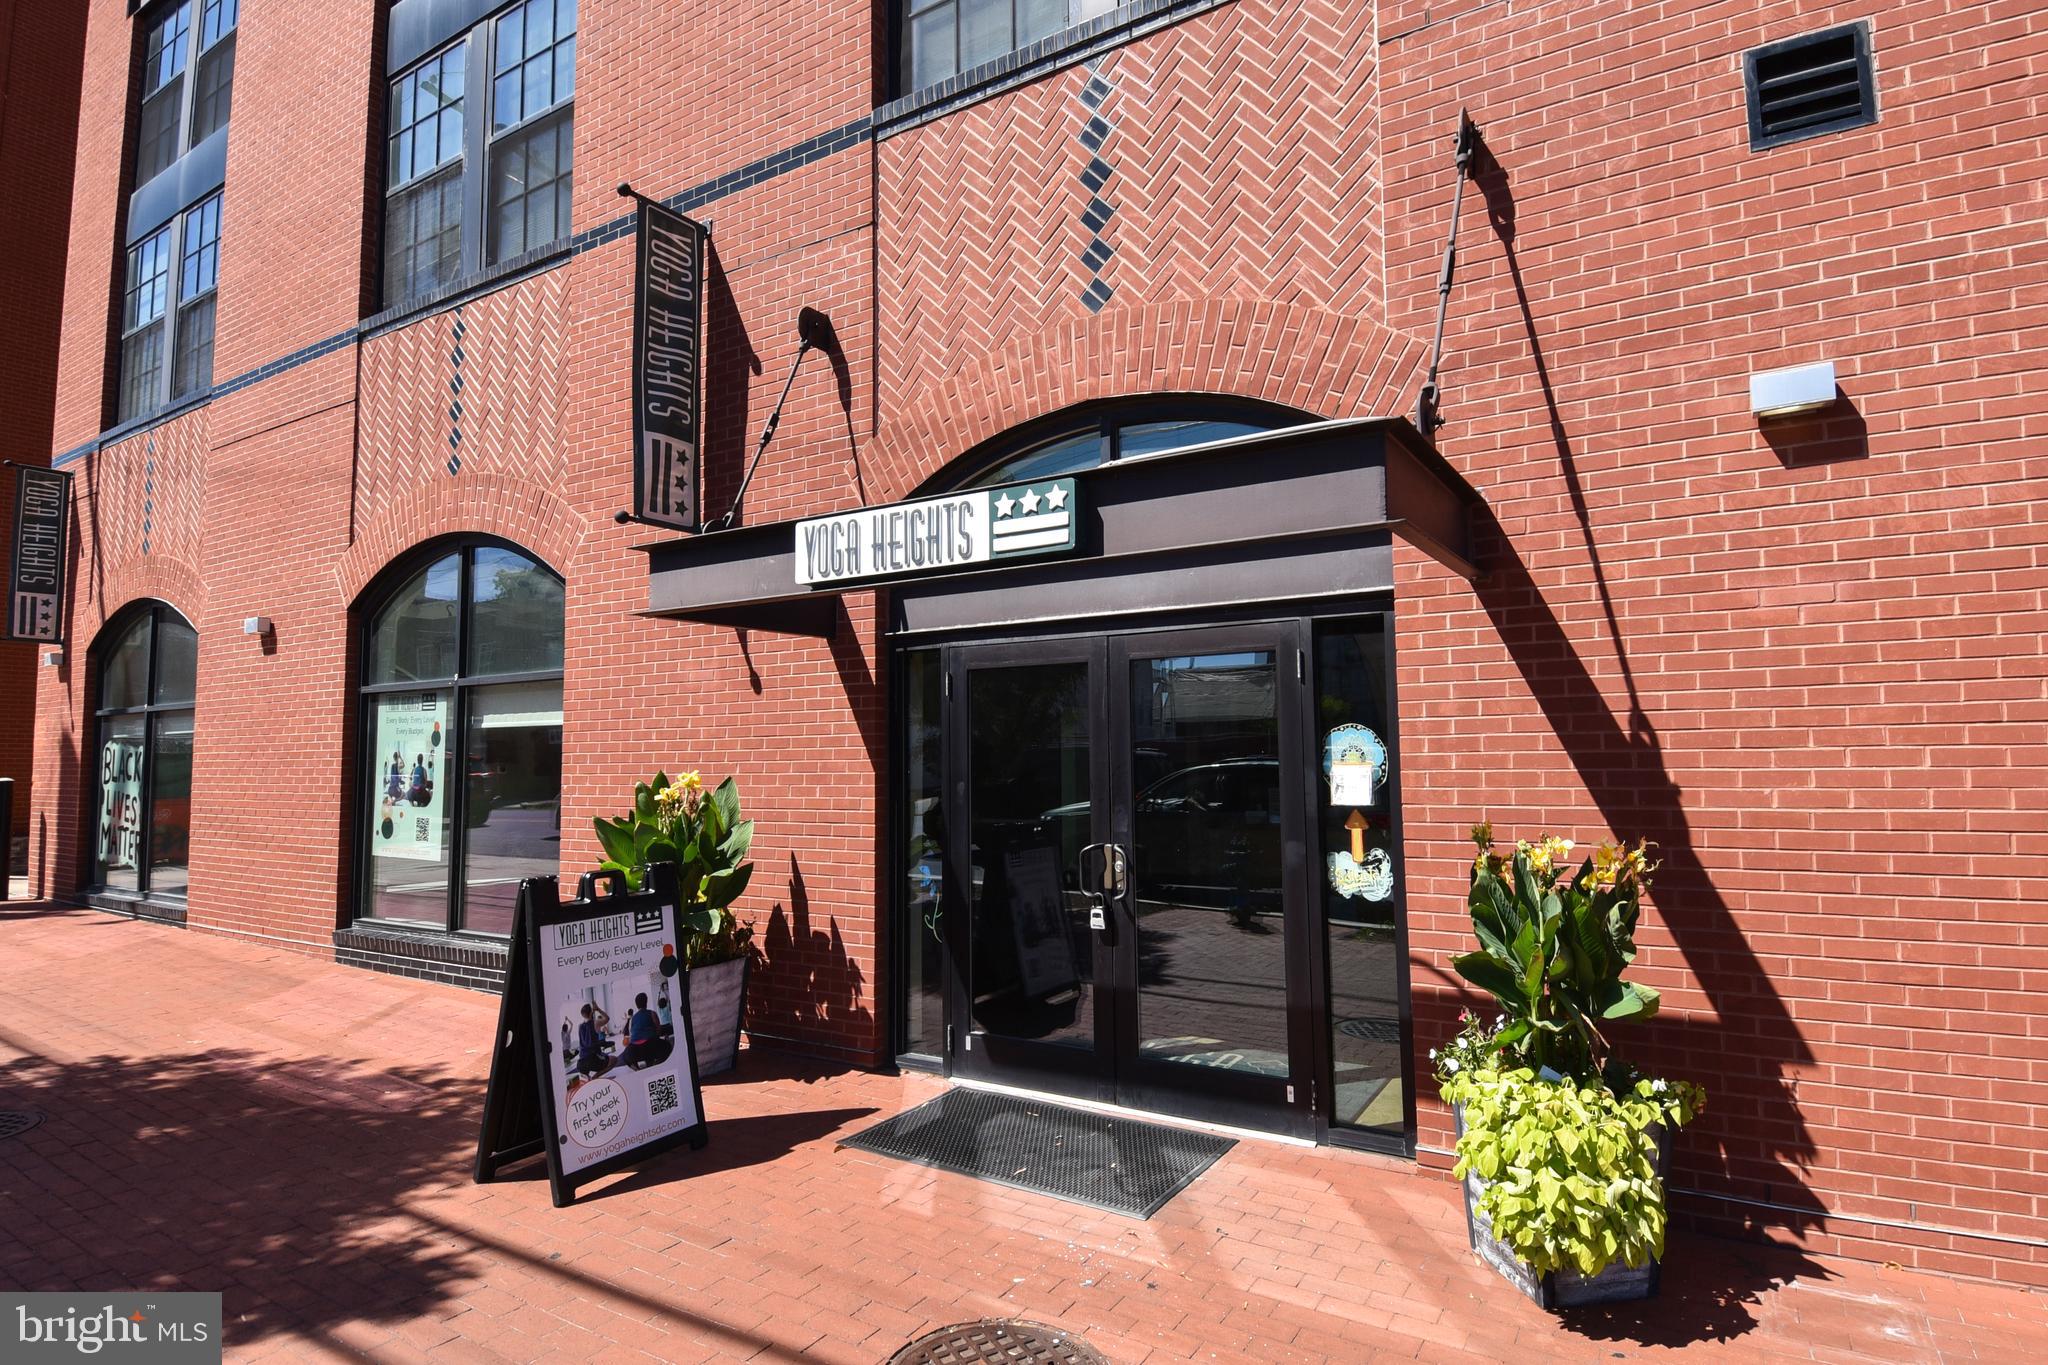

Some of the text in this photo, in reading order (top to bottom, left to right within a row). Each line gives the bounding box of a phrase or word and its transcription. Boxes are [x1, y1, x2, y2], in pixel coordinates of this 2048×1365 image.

[646, 223, 694, 426] YOGA HEIGHTS
[20, 479, 61, 585] YOGA HEIGHTS
[804, 500, 974, 580] YOGA HEIGHTS
[103, 747, 142, 785] BLACK
[106, 789, 137, 827] LIVES
[100, 821, 140, 865] MATTER
[558, 914, 630, 947] YOGA HEIGHTS
[557, 952, 584, 968] Every
[614, 943, 639, 957] Every
[583, 965, 609, 979] Every
[571, 1084, 612, 1113] Try your
[572, 1096, 621, 1131] first week
[577, 1116, 686, 1165] www.yogaheightsdc.com
[583, 1110, 622, 1142] for $49!
